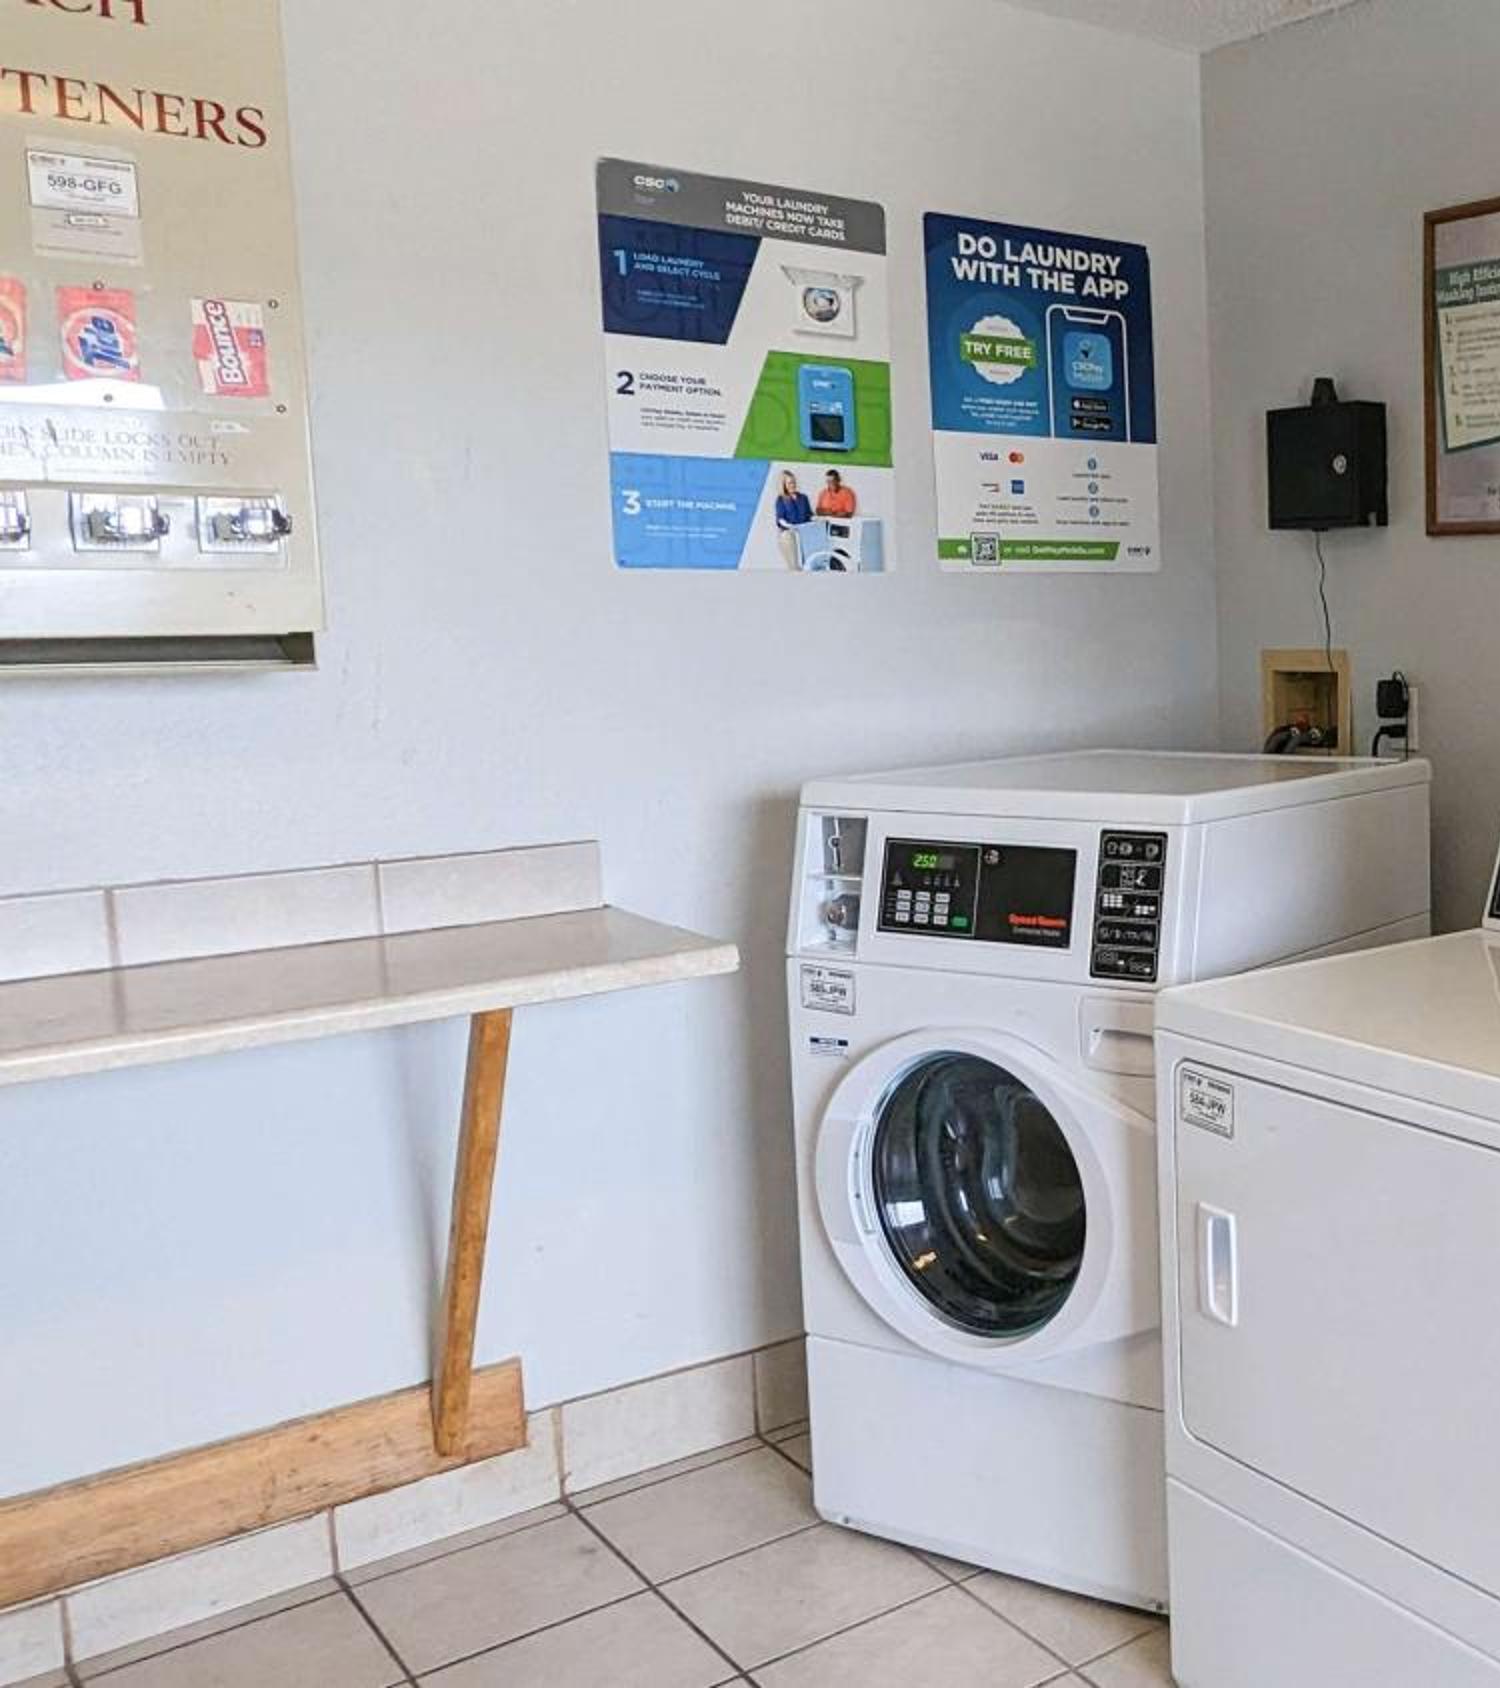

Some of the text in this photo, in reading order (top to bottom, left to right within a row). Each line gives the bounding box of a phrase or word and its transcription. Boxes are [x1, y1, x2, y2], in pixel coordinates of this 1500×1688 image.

[1, 68, 267, 148] TENERS
[47, 174, 122, 195] 598-GFG
[725, 201, 845, 229] MACHINES NOW TAKE
[742, 192, 829, 215] YOUR LAUNDRY
[765, 219, 806, 235] CREDIT
[808, 226, 846, 241] CARDS
[613, 249, 627, 277] 1
[957, 232, 1121, 276] DO LAUNDRY
[951, 257, 1129, 300] WITH THE APP
[77, 315, 131, 370] Tide
[964, 340, 1032, 360] TRY FREE
[615, 370, 636, 396] 2
[640, 373, 706, 386] CHOOSE YOUR
[640, 382, 684, 394] PAYMENT
[104, 431, 171, 446] LOCKS
[178, 433, 219, 449] OUT
[621, 488, 642, 515] 3
